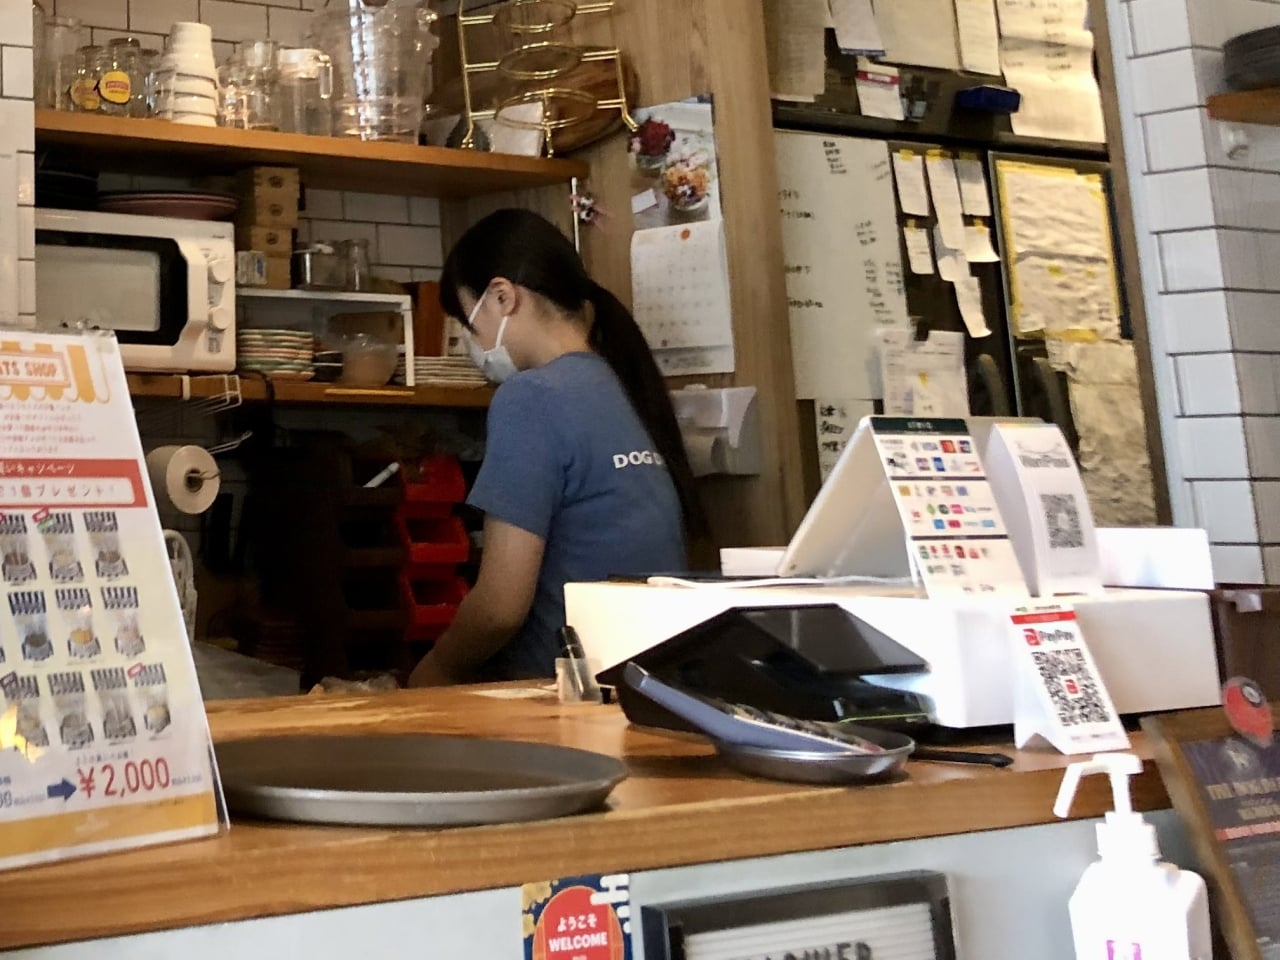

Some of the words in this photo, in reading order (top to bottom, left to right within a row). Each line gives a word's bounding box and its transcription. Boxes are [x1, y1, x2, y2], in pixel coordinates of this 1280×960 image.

[24, 360, 58, 378] SHOP
[612, 450, 664, 469] DOGD
[76, 756, 171, 800] ¥2,000
[557, 913, 598, 933] ようこそ
[548, 932, 609, 952] WELCOME
